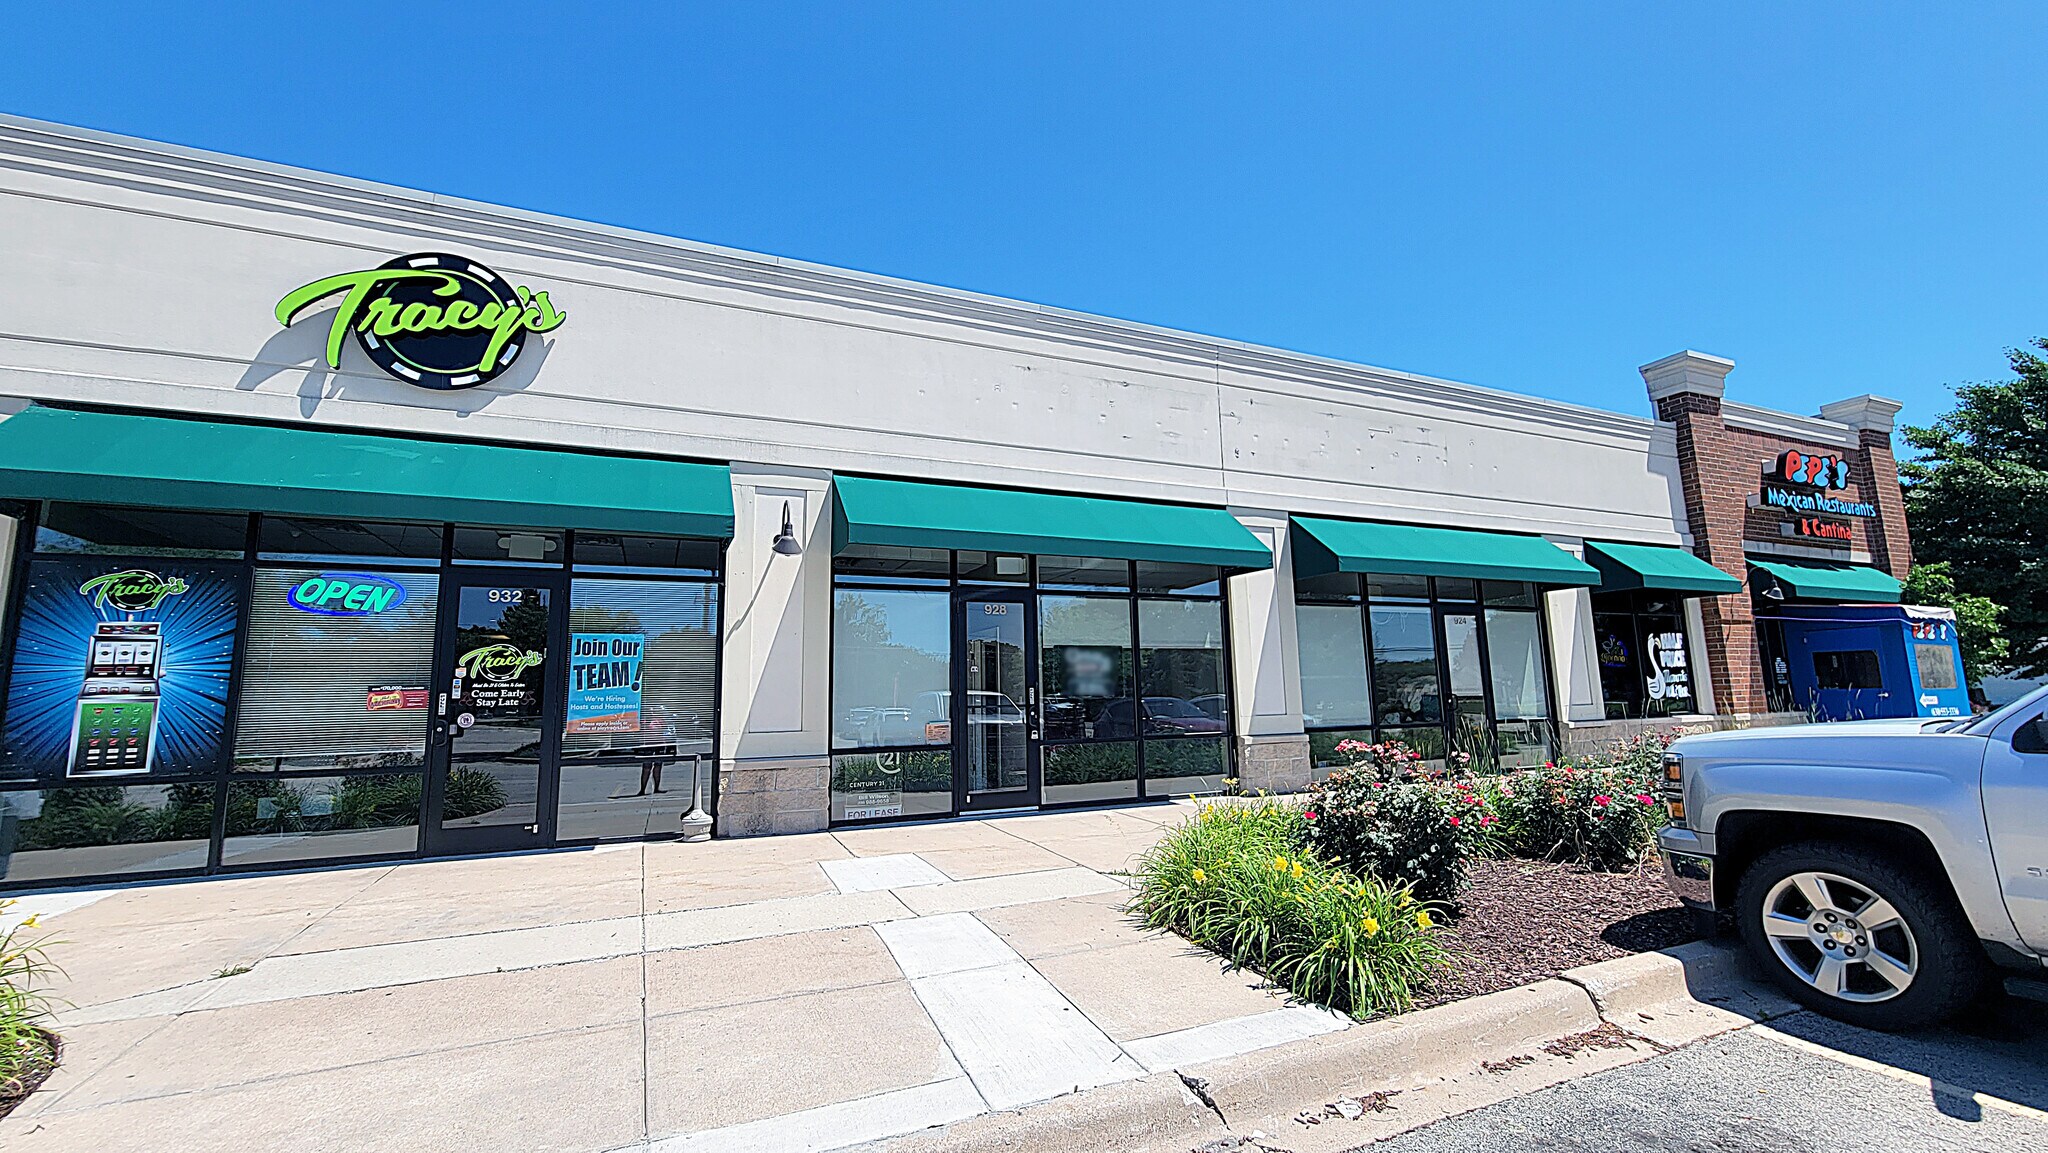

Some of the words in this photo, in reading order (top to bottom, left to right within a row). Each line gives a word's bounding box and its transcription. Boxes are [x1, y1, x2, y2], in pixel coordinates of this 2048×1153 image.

[275, 268, 566, 371] Tracy's
[1785, 450, 1849, 489] PEPE'S
[1767, 486, 1816, 513] Mexican
[1814, 492, 1877, 518] Restaurants
[1812, 517, 1852, 540] Cantina
[80, 572, 190, 609] Tracy's
[295, 577, 396, 613] OPEN
[488, 589, 523, 603] 932
[984, 604, 1007, 615] 928
[1453, 617, 1467, 625] 924
[574, 638, 608, 657] Join
[611, 638, 641, 658] Our
[459, 646, 543, 680] Tracy's
[573, 660, 644, 692] TEAM!
[471, 690, 499, 698] Come
[500, 689, 526, 699] Early
[476, 699, 497, 708] Stay
[498, 698, 520, 706] Late
[605, 695, 626, 703] Hiring
[604, 702, 639, 710] Hostesses!
[847, 811, 867, 819] FOR
